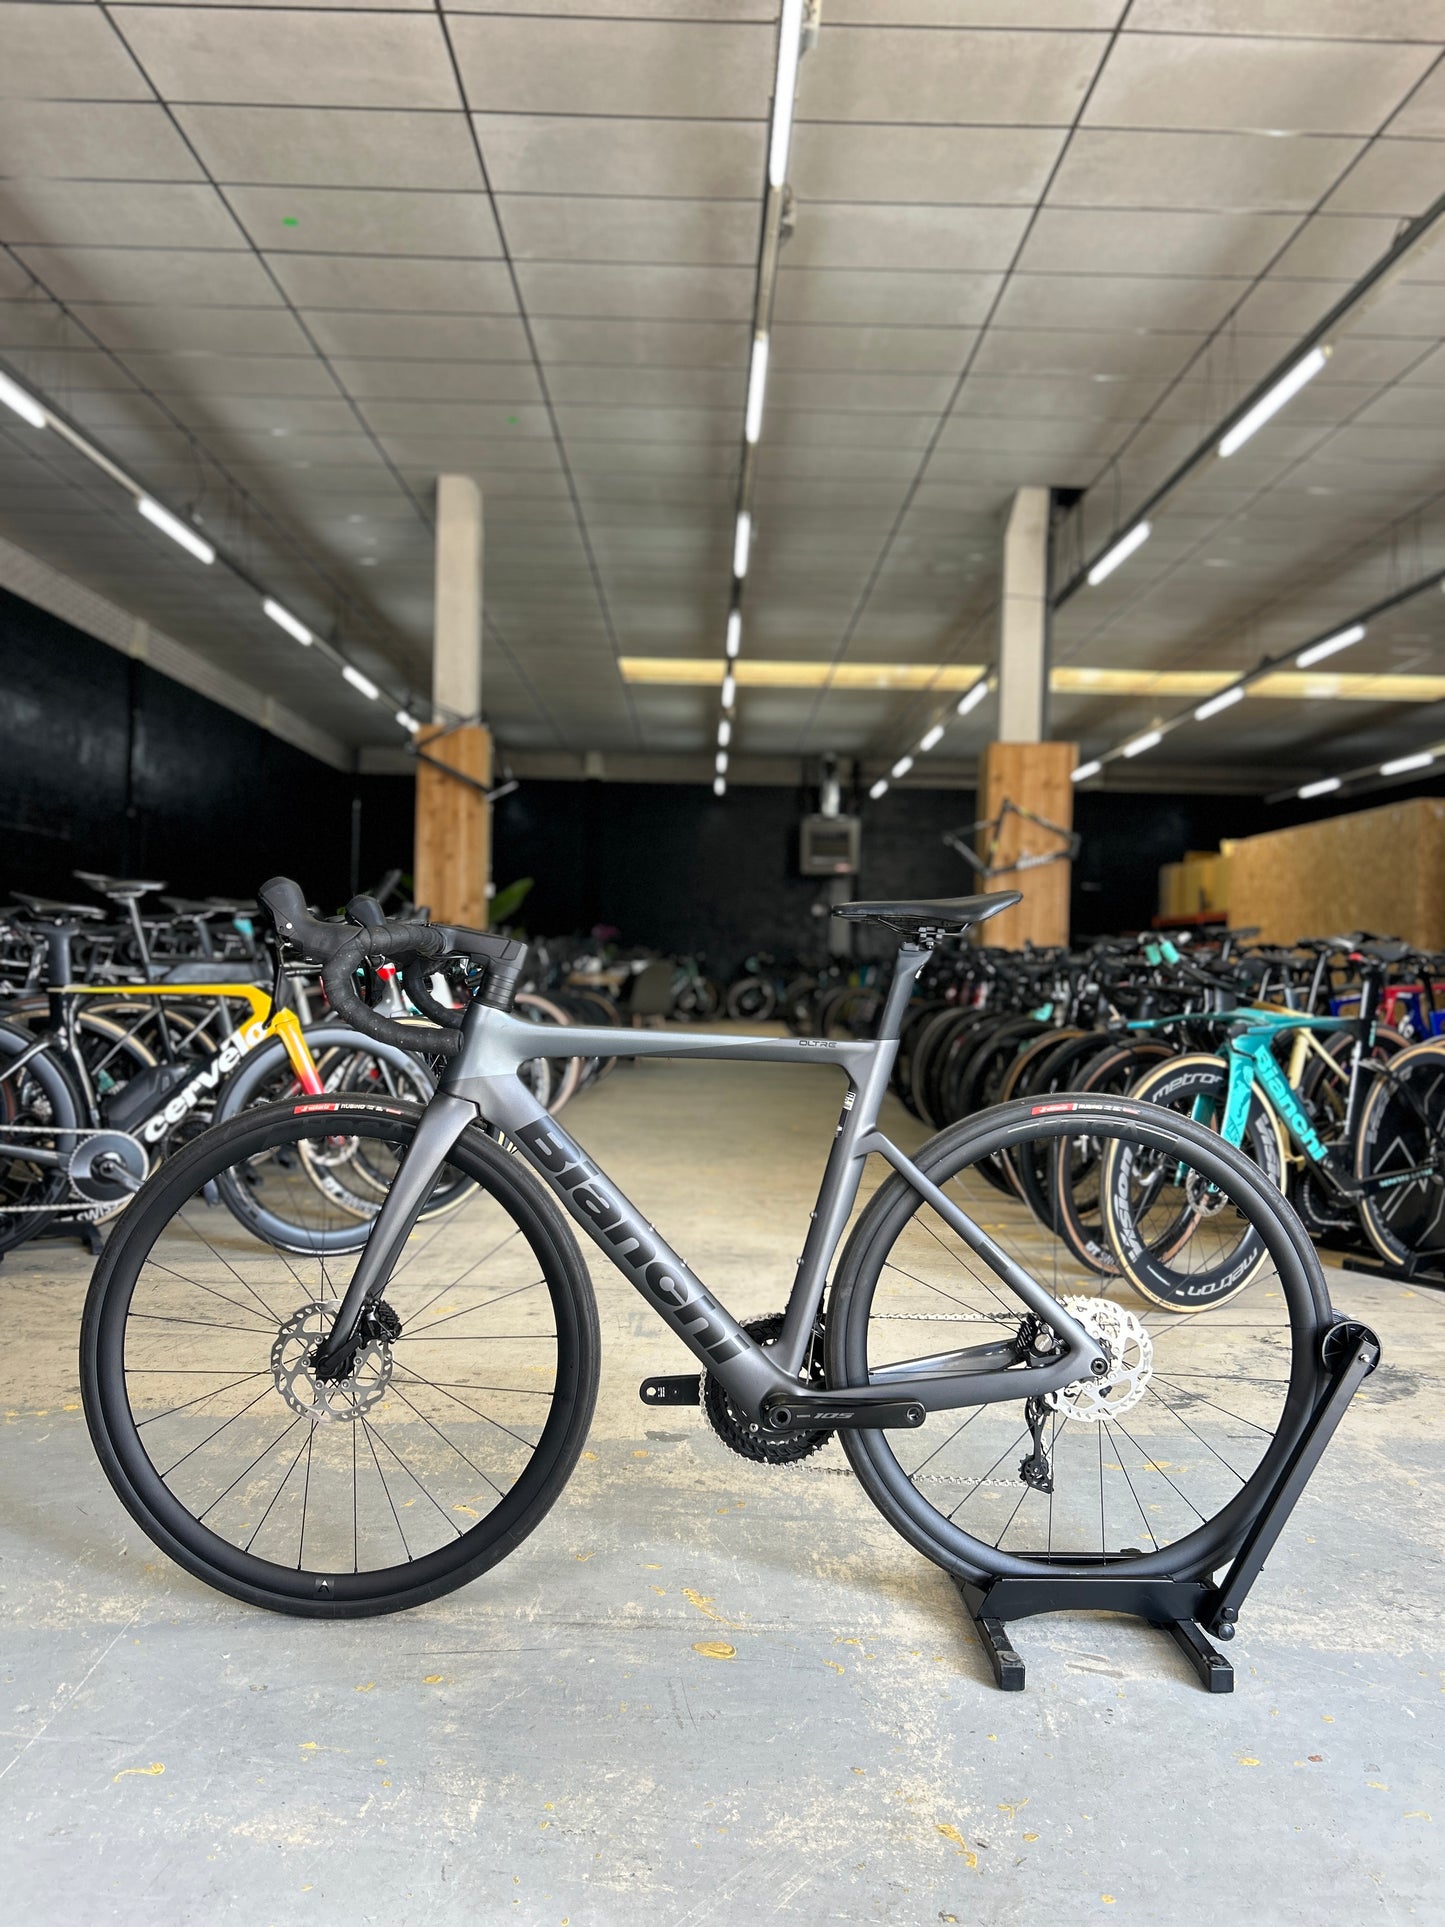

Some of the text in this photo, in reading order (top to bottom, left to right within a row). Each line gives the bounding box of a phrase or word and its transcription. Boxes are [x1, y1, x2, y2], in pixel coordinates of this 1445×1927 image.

[798, 1040, 837, 1049] OLTRE
[1254, 1044, 1329, 1161] Bianchi
[514, 1115, 751, 1365] Bianchi
